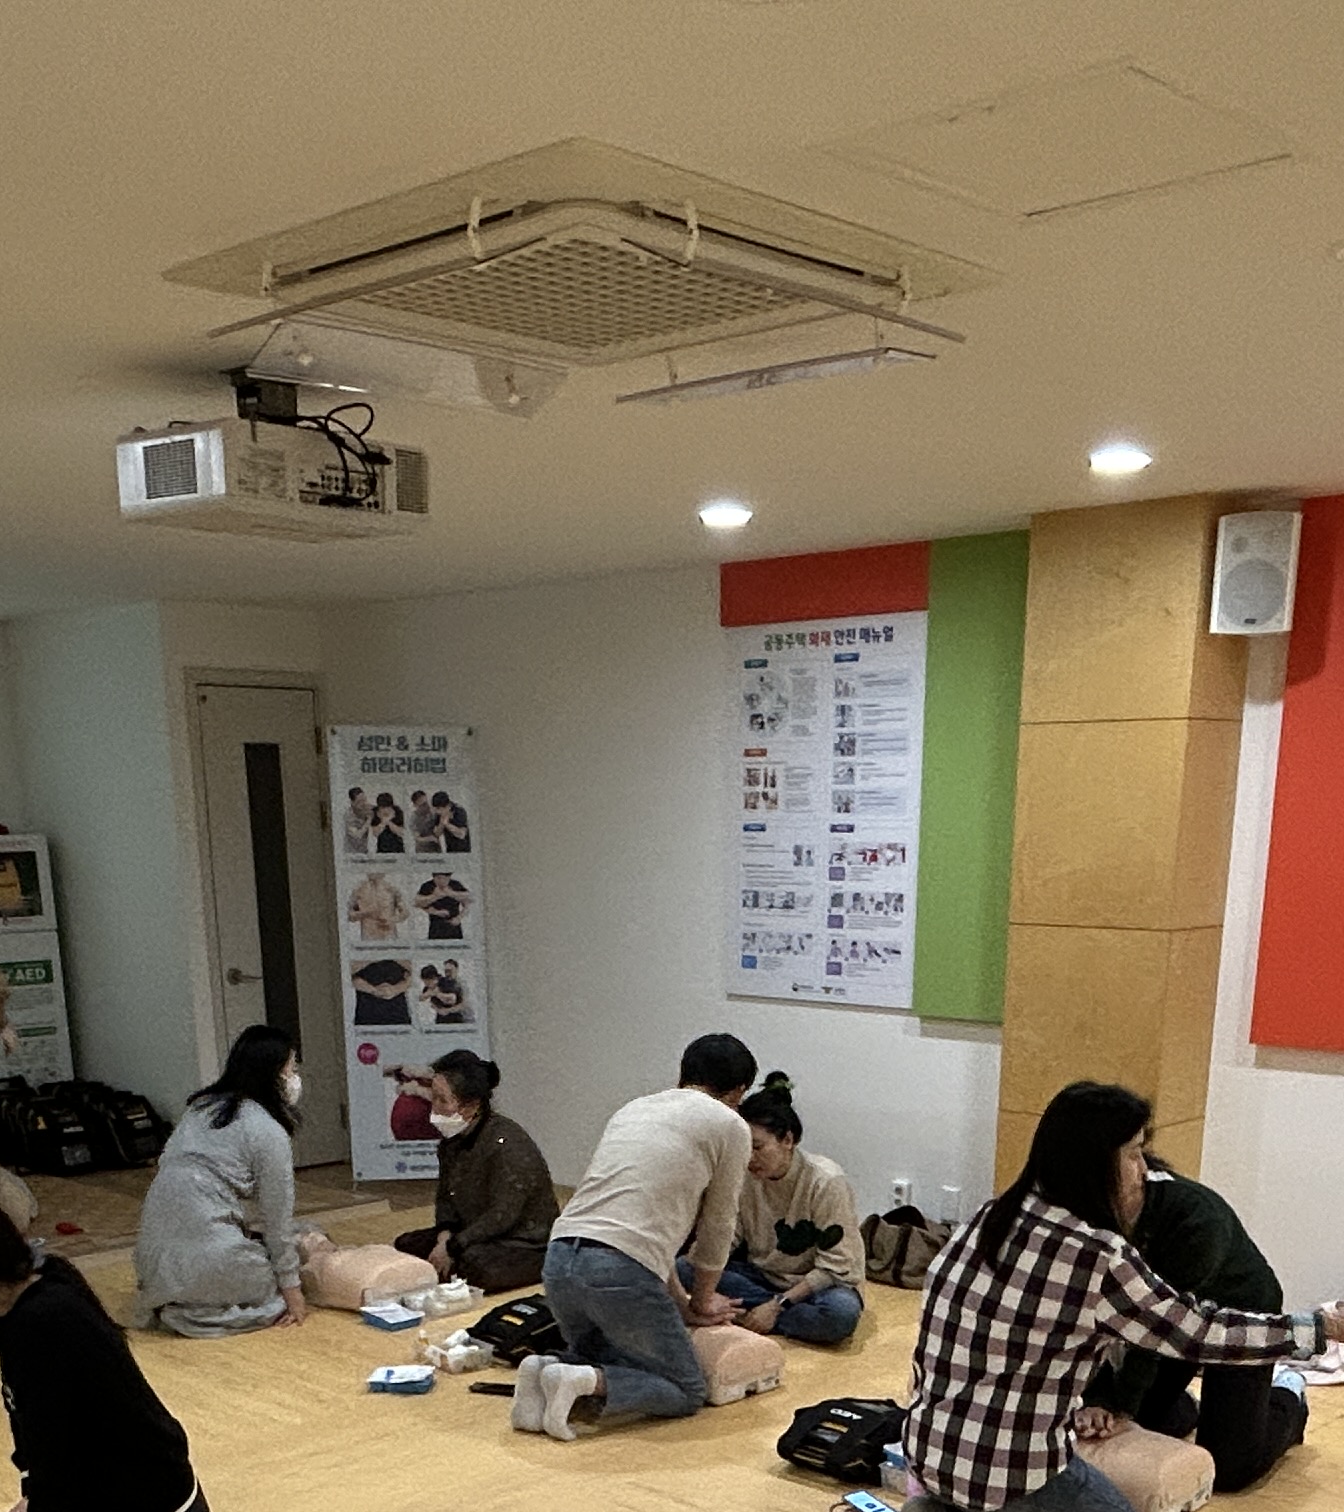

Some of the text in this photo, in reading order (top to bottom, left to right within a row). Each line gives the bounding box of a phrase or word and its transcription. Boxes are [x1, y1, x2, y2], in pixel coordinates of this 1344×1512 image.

[833, 627, 856, 646] 안전
[859, 625, 894, 643] 매뉴얼
[15, 967, 47, 982] AED
